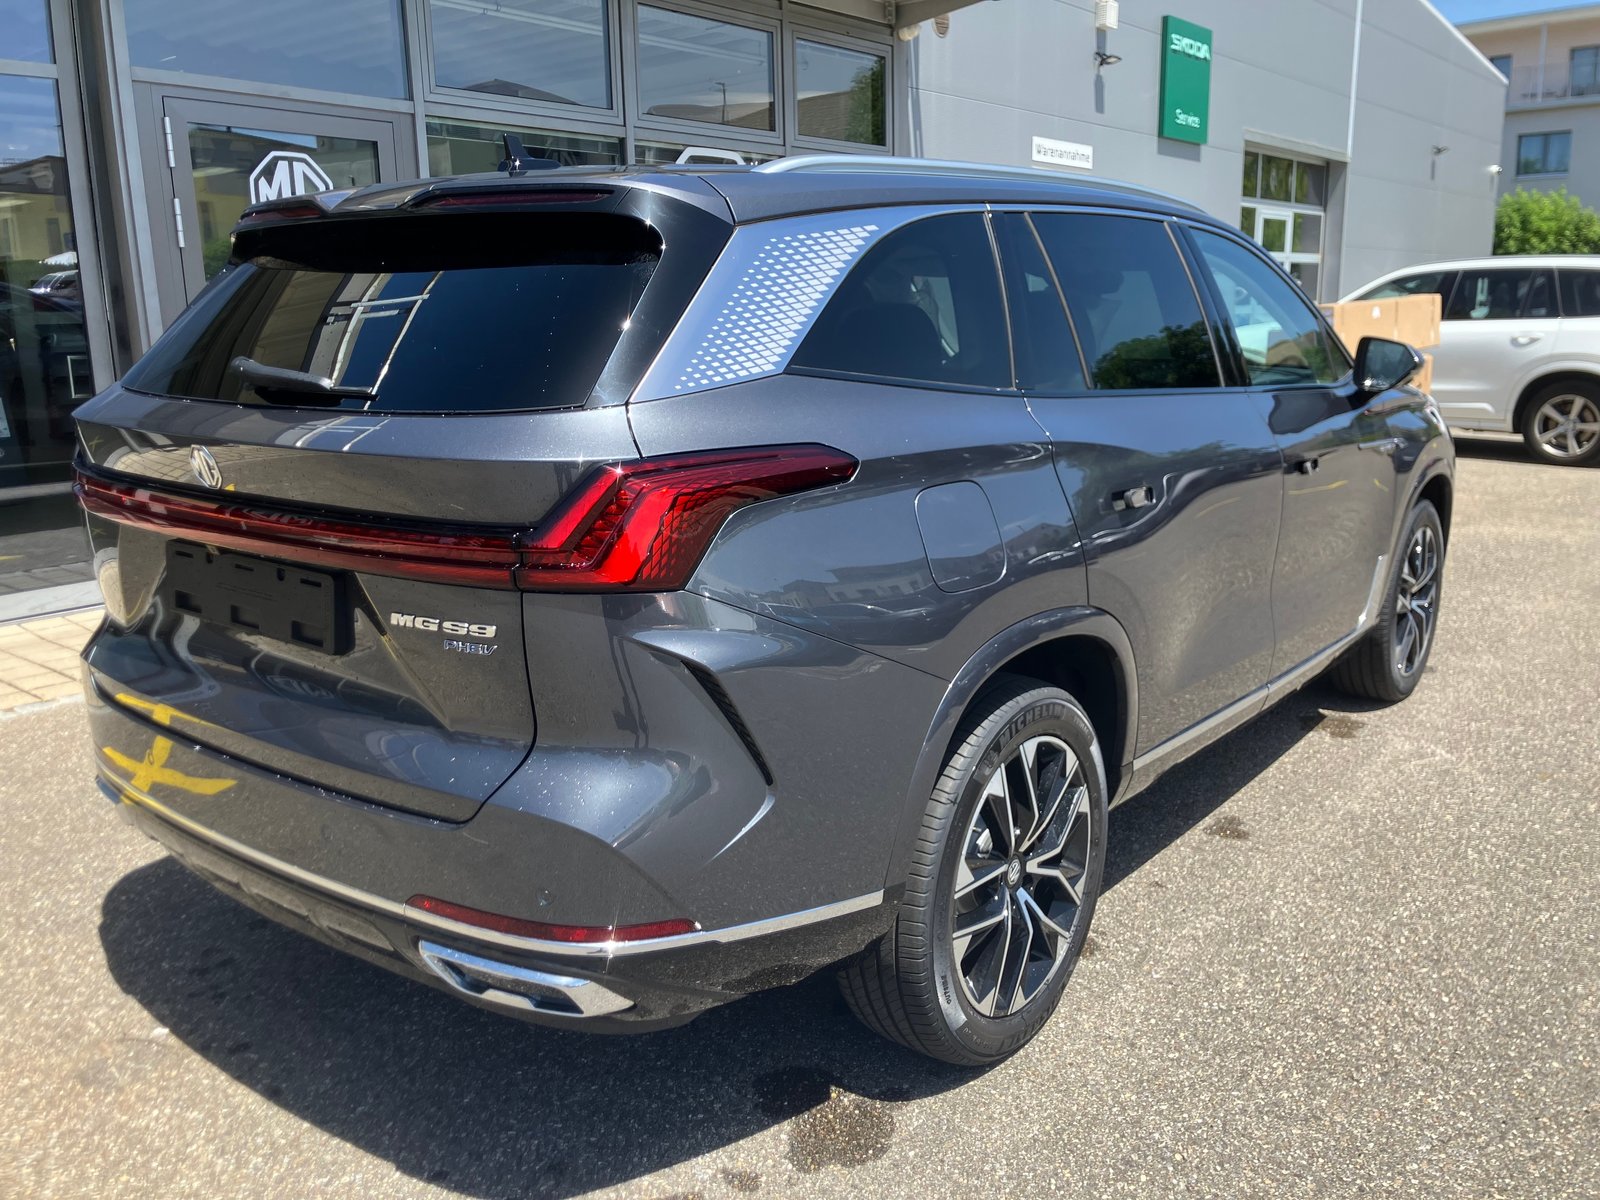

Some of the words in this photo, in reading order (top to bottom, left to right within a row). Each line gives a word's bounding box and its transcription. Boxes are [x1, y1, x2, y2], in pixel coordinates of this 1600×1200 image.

[1174, 108, 1200, 129] Service
[192, 447, 219, 487] MG
[390, 612, 440, 631] MG
[442, 621, 497, 638] S9
[443, 639, 498, 656] PHEV
[1000, 703, 1063, 751] MICHELIN
